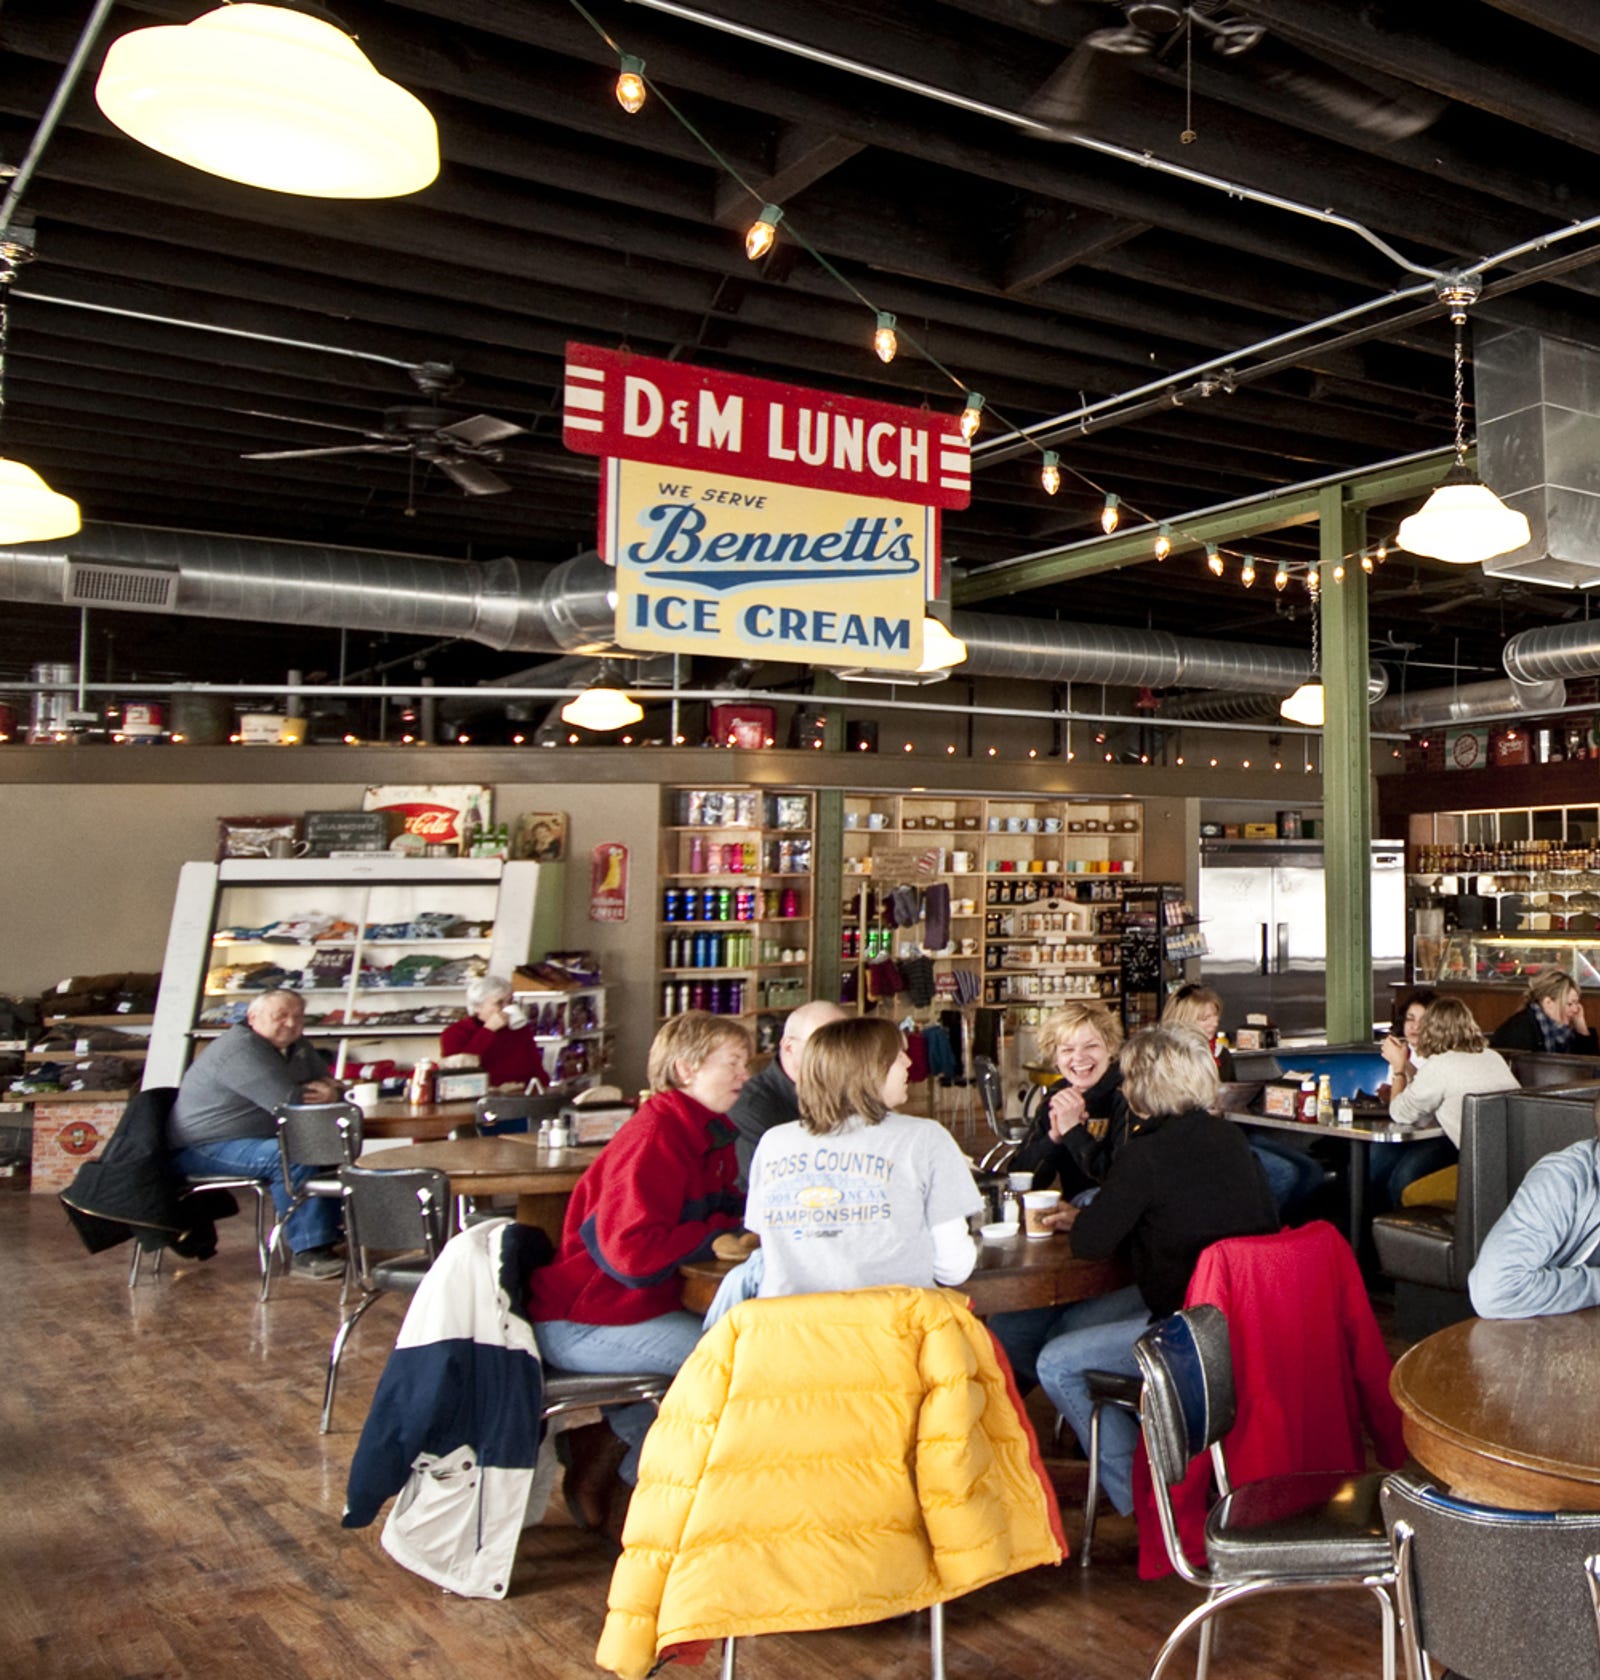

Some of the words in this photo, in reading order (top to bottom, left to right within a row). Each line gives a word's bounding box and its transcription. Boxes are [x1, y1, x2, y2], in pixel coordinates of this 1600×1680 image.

[623, 375, 743, 453] D&M
[768, 402, 929, 483] LUNCH
[658, 482, 690, 499] WE
[701, 487, 768, 510] SERVE
[627, 503, 920, 575] Bennett's
[634, 594, 722, 634] ICE
[743, 603, 911, 650] CREAM
[814, 1148, 894, 1183] COUNTRY
[764, 1203, 892, 1225] HAMPIONSHIPS
